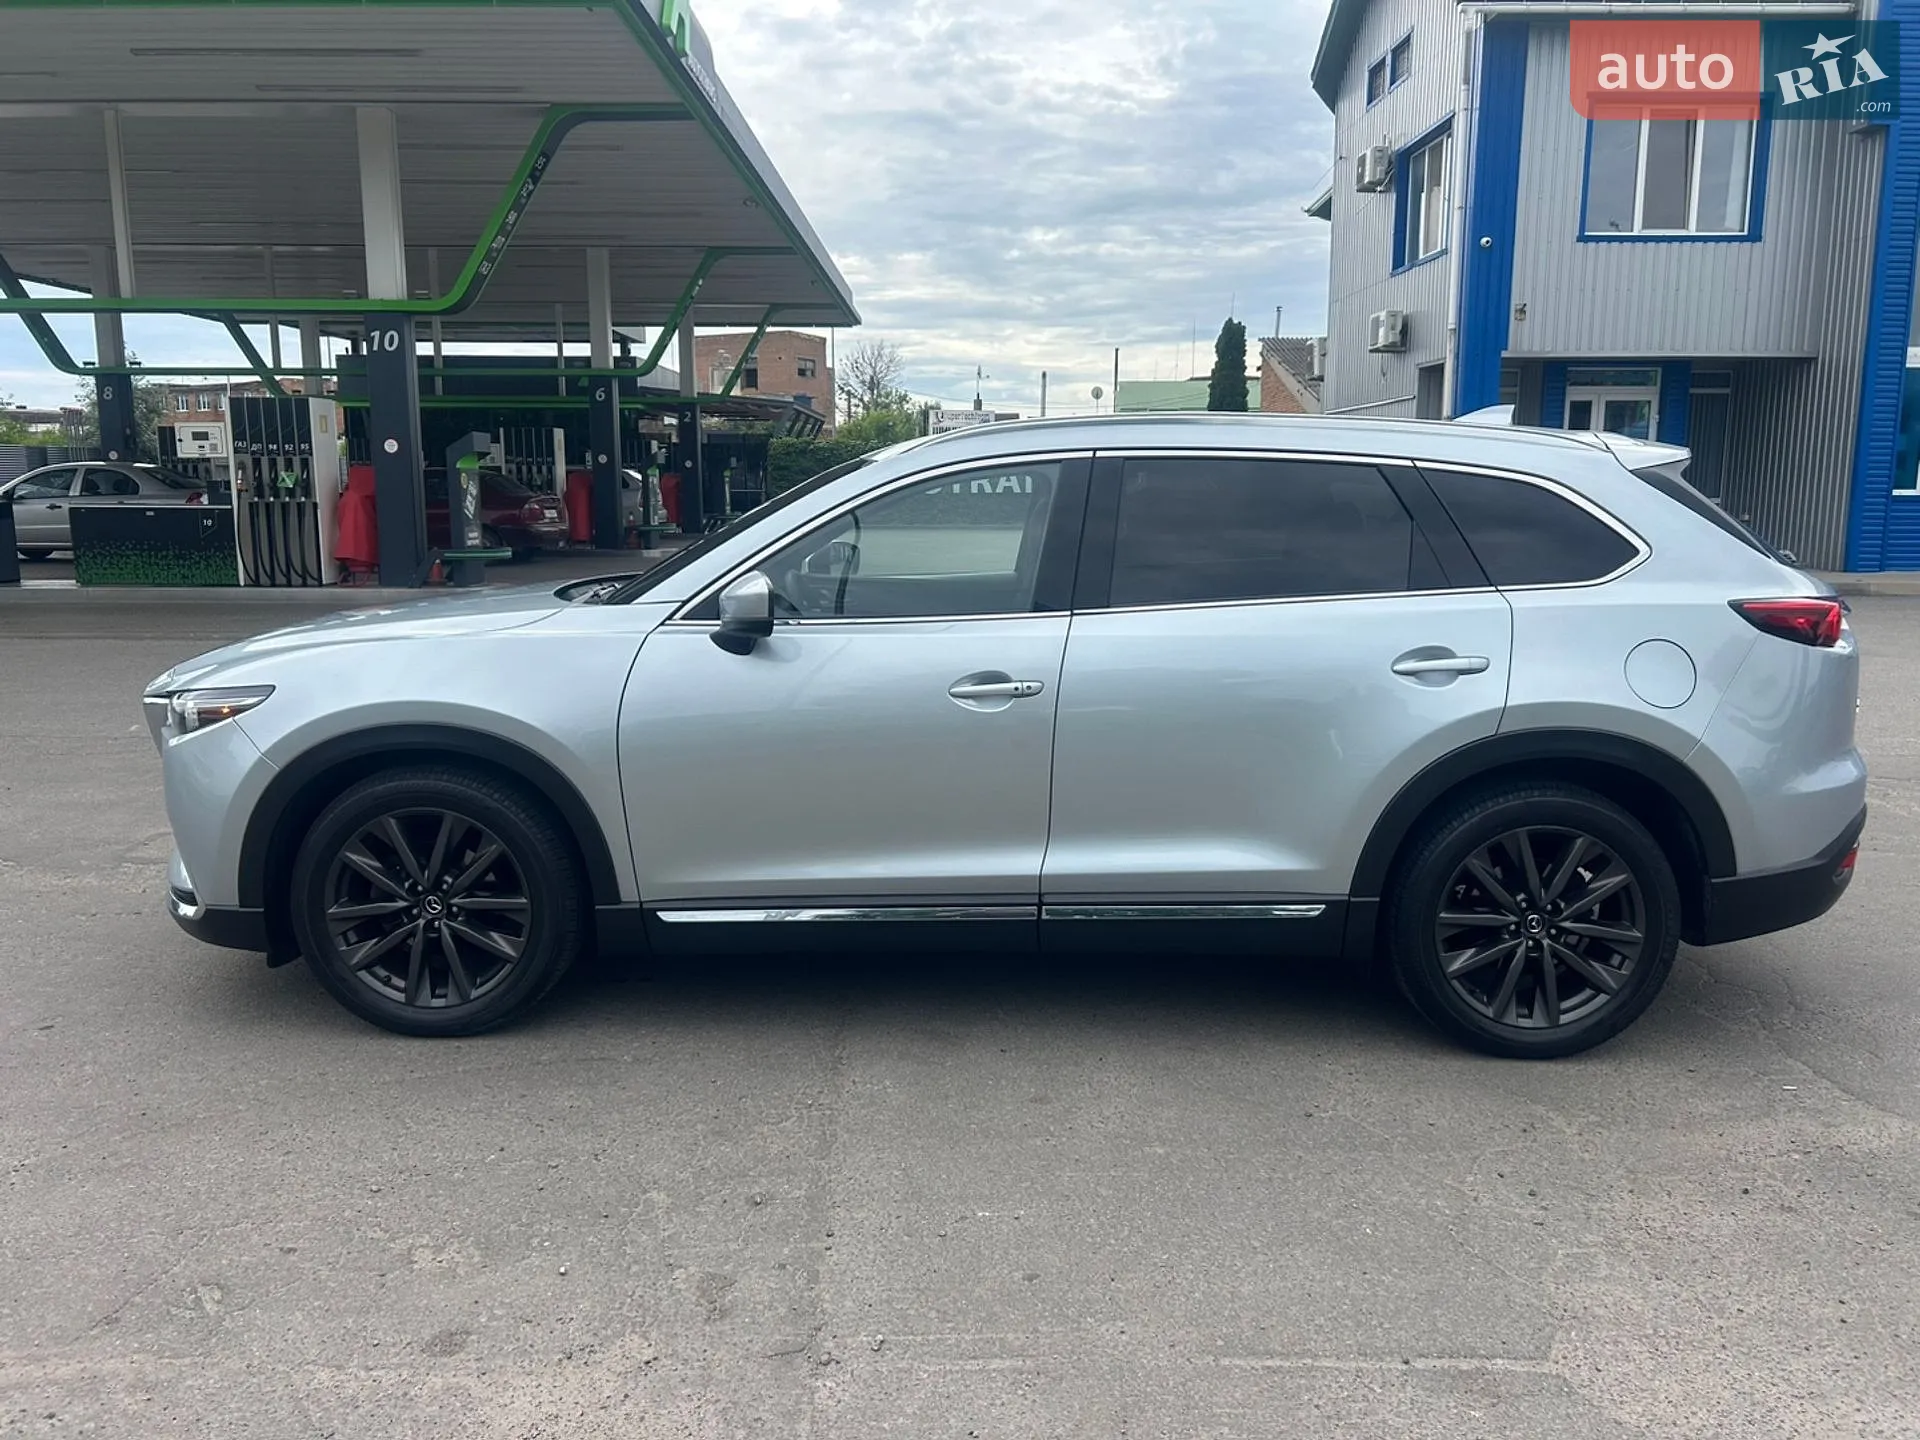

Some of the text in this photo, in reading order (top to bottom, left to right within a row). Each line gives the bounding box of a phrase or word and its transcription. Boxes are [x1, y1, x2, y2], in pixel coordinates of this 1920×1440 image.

[370, 330, 399, 351] 10
[103, 386, 113, 400] 8
[595, 387, 606, 401] 6
[683, 411, 692, 423] 2
[203, 519, 213, 527] 10
